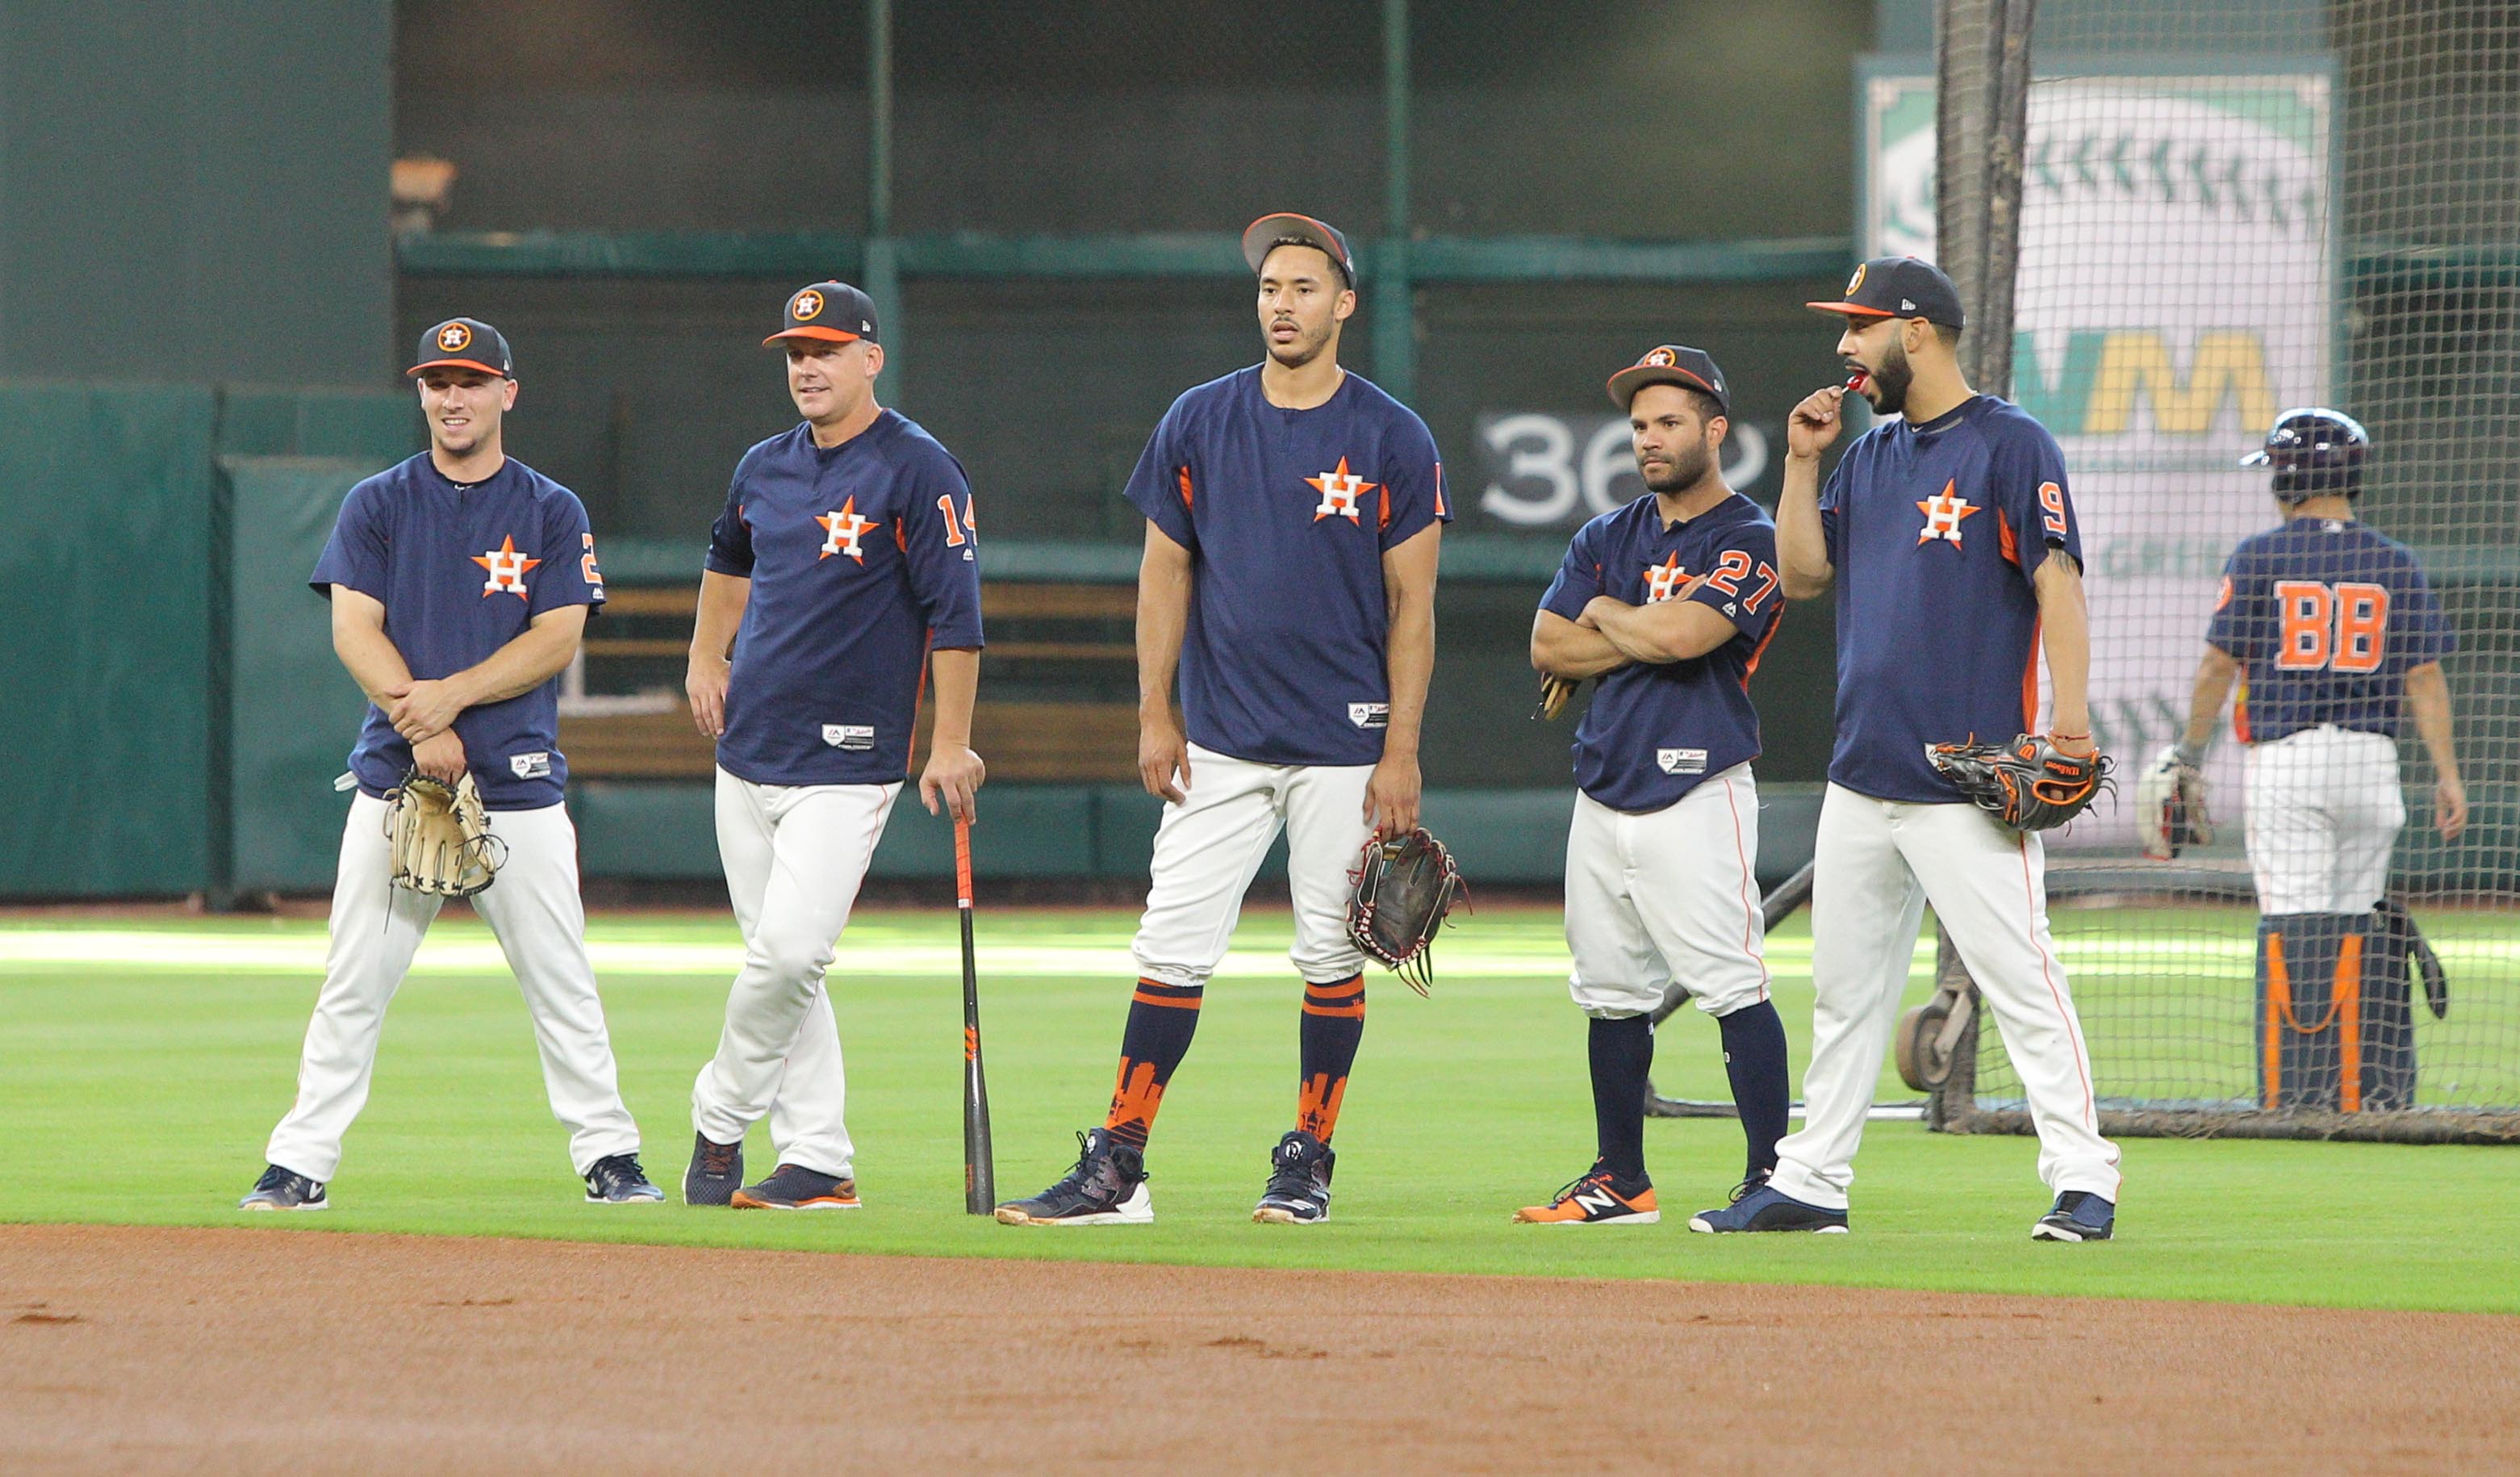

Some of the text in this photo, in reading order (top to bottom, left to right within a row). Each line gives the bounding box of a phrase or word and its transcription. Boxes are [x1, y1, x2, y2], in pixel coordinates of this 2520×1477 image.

[797, 298, 816, 315] H
[444, 329, 462, 345] H
[1316, 471, 1363, 517] H
[2038, 481, 2067, 535] 9
[821, 511, 867, 556] H
[1920, 496, 1967, 541] H
[486, 550, 527, 593] H
[1647, 564, 1685, 604] H
[1706, 550, 1779, 615] 27
[2274, 580, 2390, 674] BB
[1574, 1187, 1617, 1215] N
